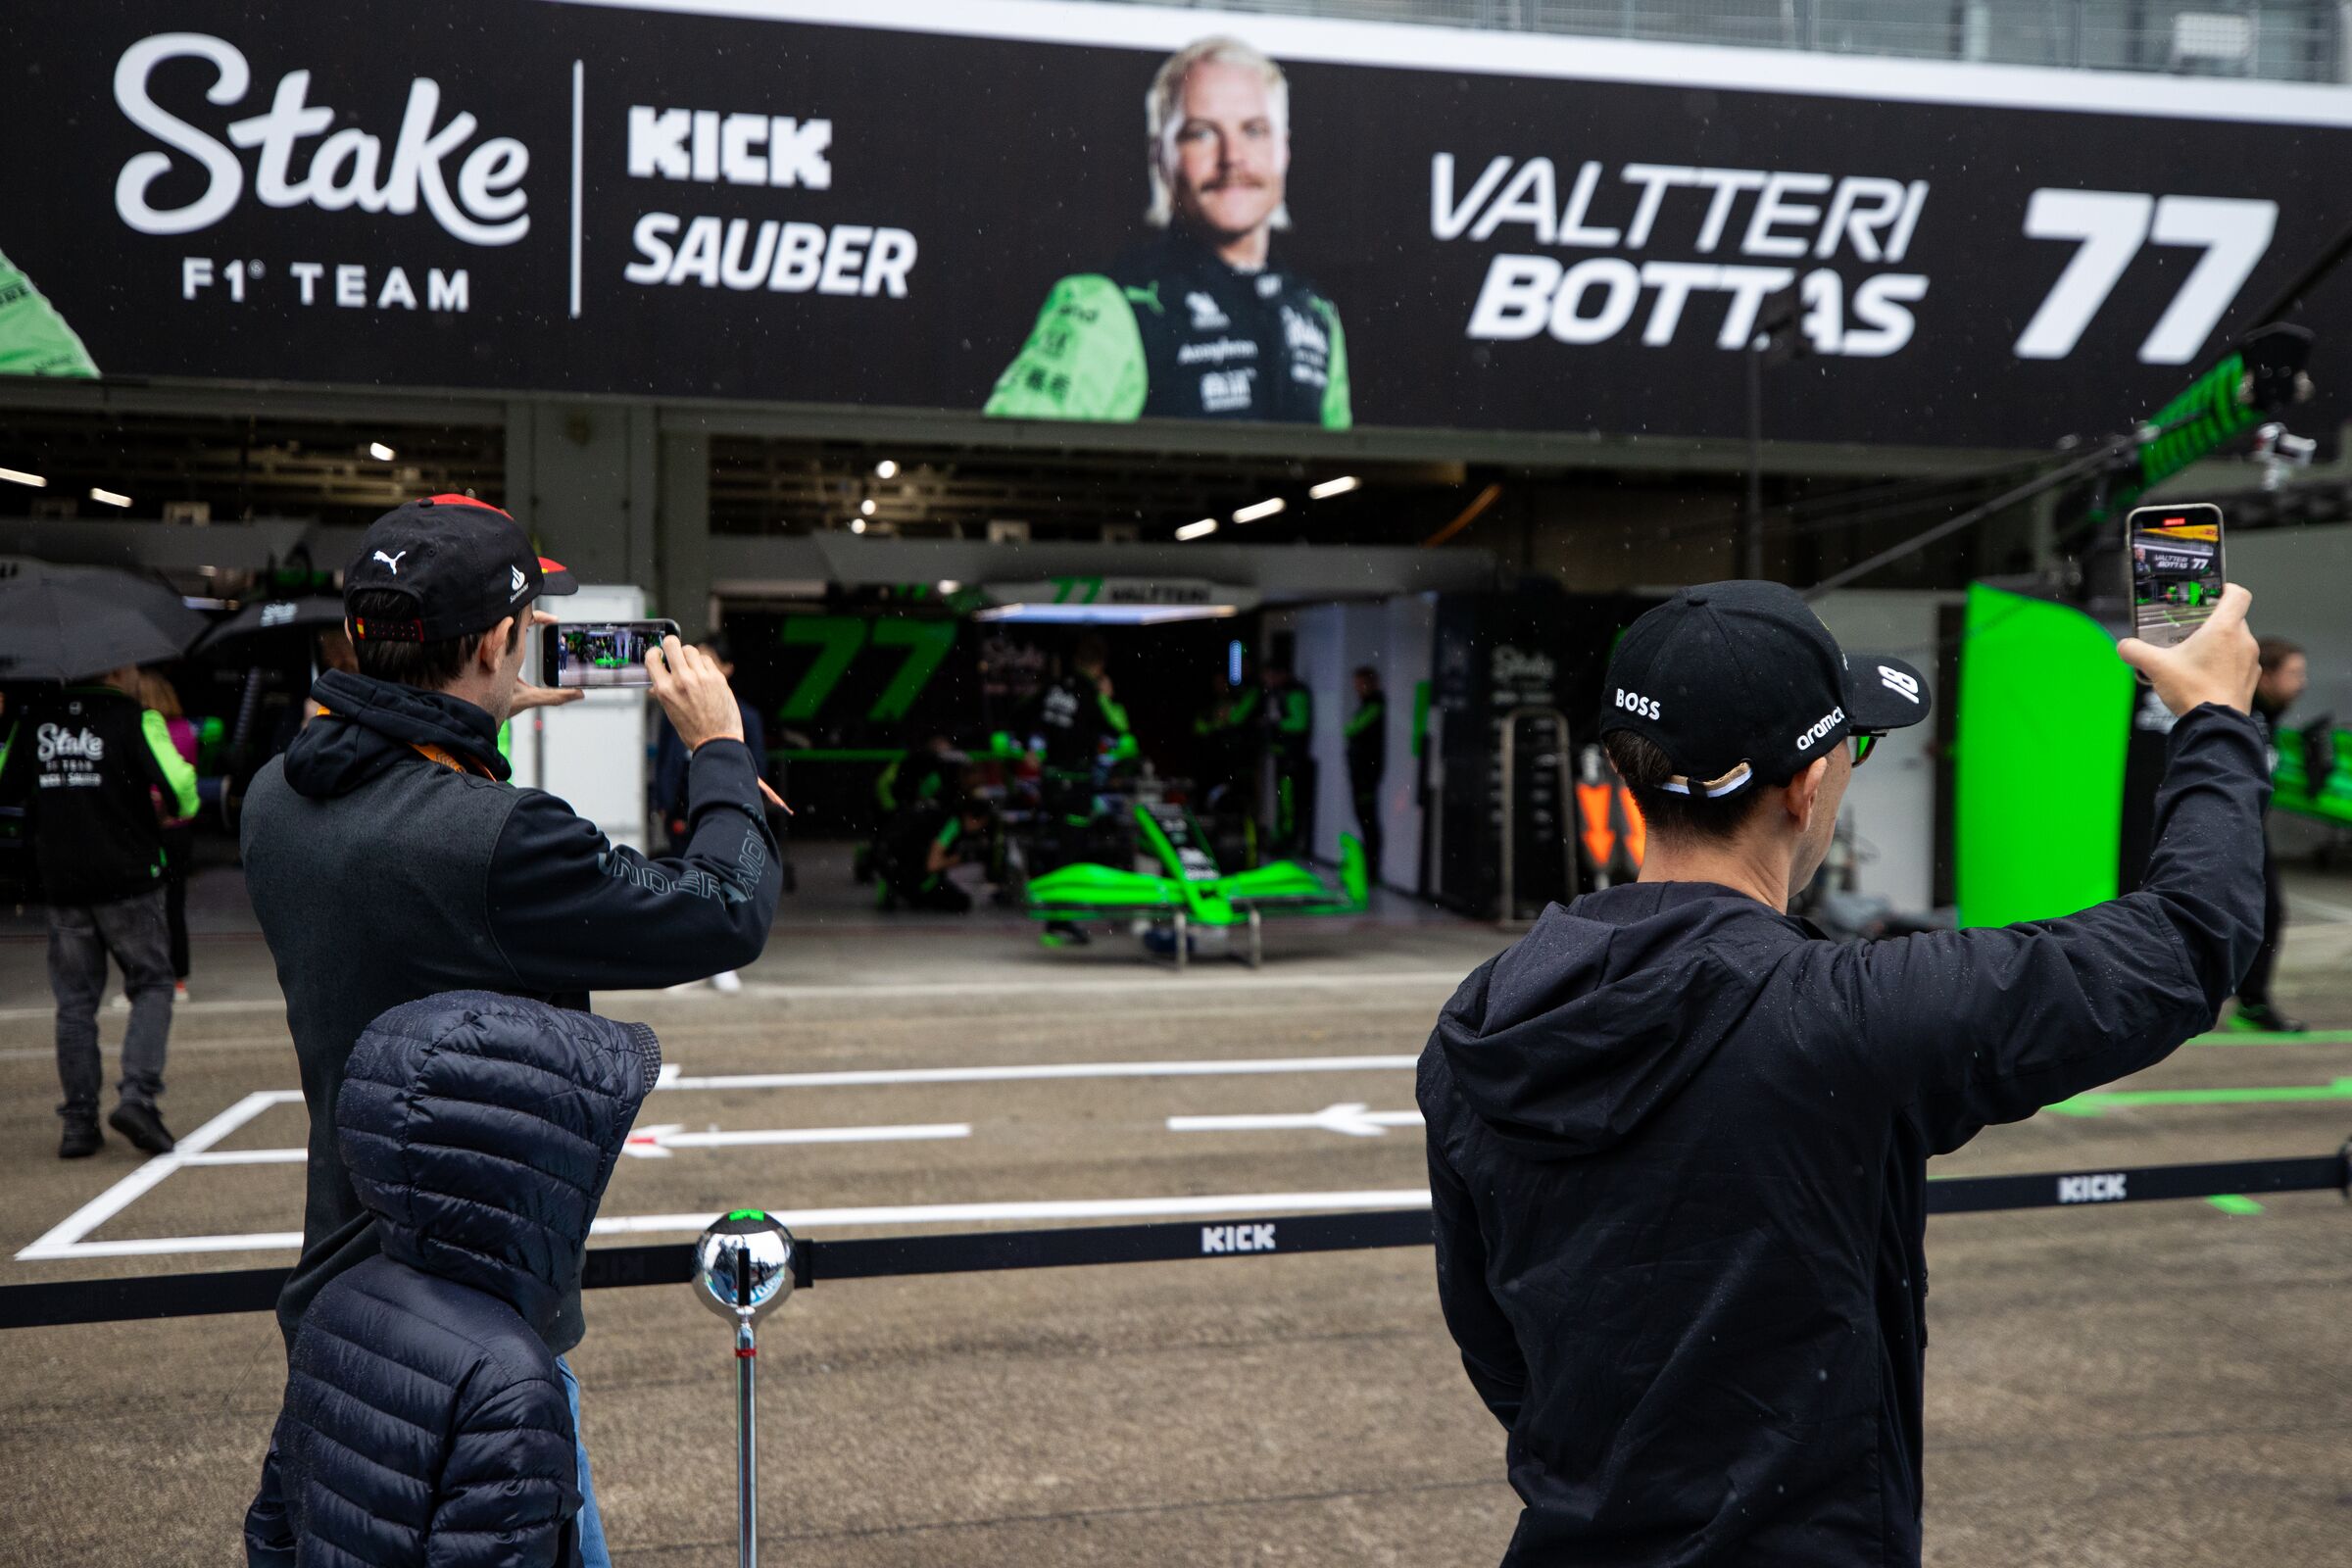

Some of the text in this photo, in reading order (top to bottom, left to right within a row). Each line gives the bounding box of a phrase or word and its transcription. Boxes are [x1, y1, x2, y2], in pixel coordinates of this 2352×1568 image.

[113, 31, 531, 247] Stake
[627, 104, 833, 190] KICK
[1430, 151, 1930, 264] VALTTERI
[289, 261, 470, 313] TEAM
[623, 211, 919, 299] SAUBER
[2012, 186, 2279, 366] 77
[1466, 253, 1930, 358] BOTTAS
[2191, 557, 2209, 569] 77
[778, 615, 958, 721] 77
[1877, 664, 1921, 705] 18
[1615, 688, 1661, 720] BOSS
[36, 722, 104, 762] Stake
[2058, 1173, 2128, 1203] KICK
[1200, 1223, 1277, 1253] KICK
